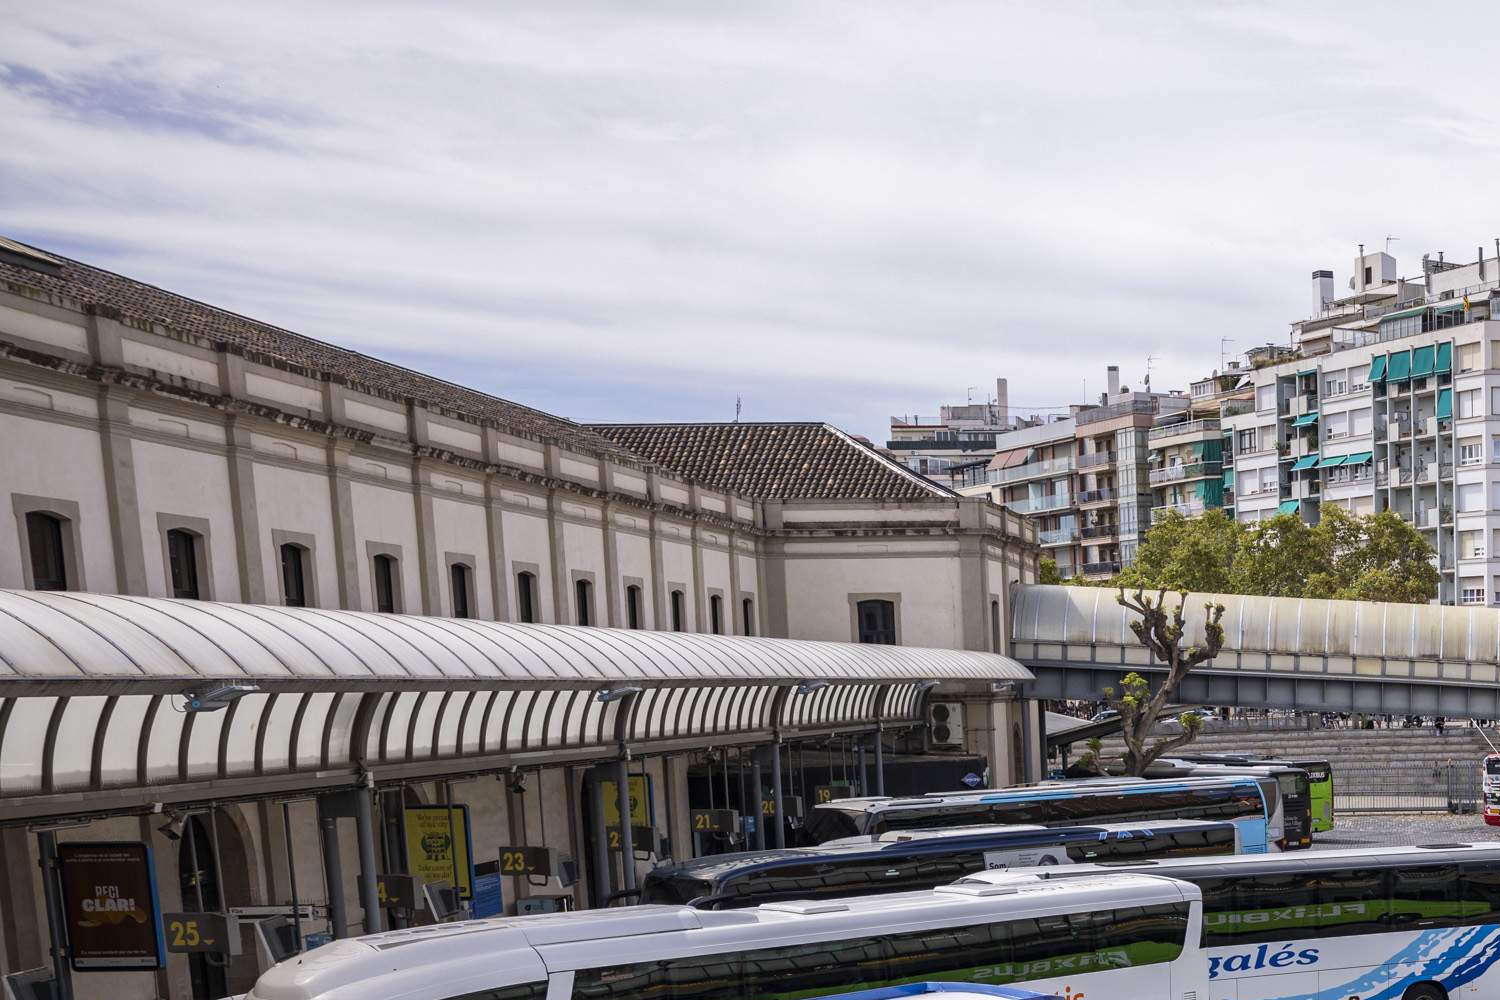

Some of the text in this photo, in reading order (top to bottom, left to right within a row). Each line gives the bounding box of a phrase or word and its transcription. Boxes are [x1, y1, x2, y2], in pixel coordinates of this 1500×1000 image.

[818, 788, 830, 802] 19
[695, 814, 711, 829] 21
[503, 852, 525, 871] 23
[80, 897, 136, 913] CLAR!
[170, 921, 200, 946] 25
